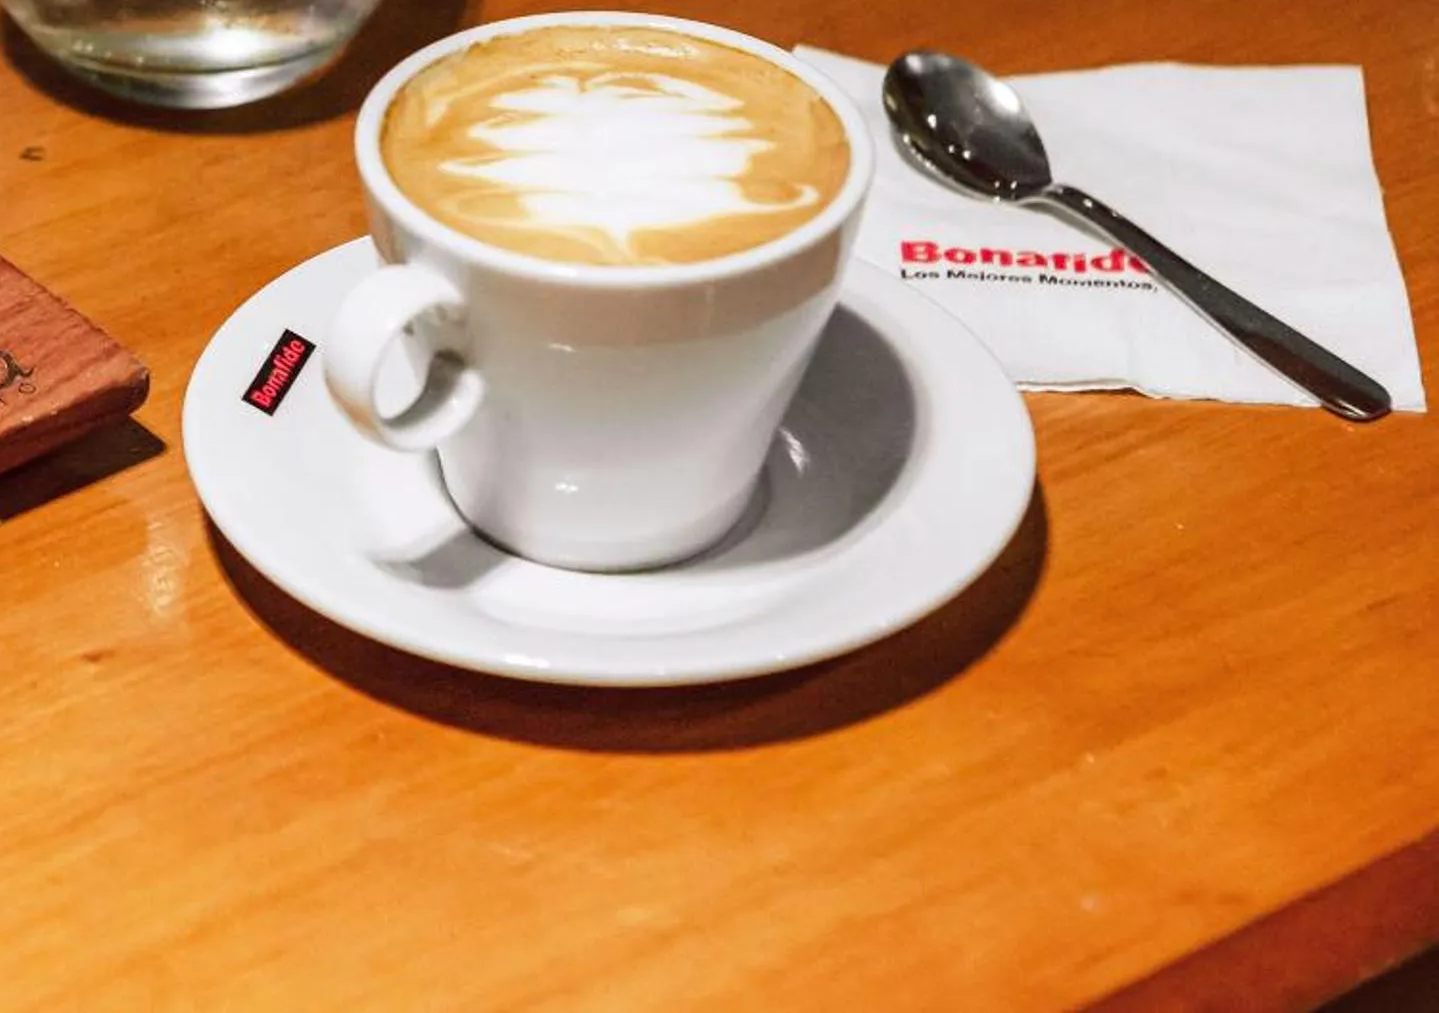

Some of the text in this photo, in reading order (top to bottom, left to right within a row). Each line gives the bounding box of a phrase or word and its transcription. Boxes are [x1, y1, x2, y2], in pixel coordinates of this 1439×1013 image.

[900, 268, 940, 279] Los
[946, 269, 1033, 284] Mejores
[251, 339, 306, 408] Bonafide
